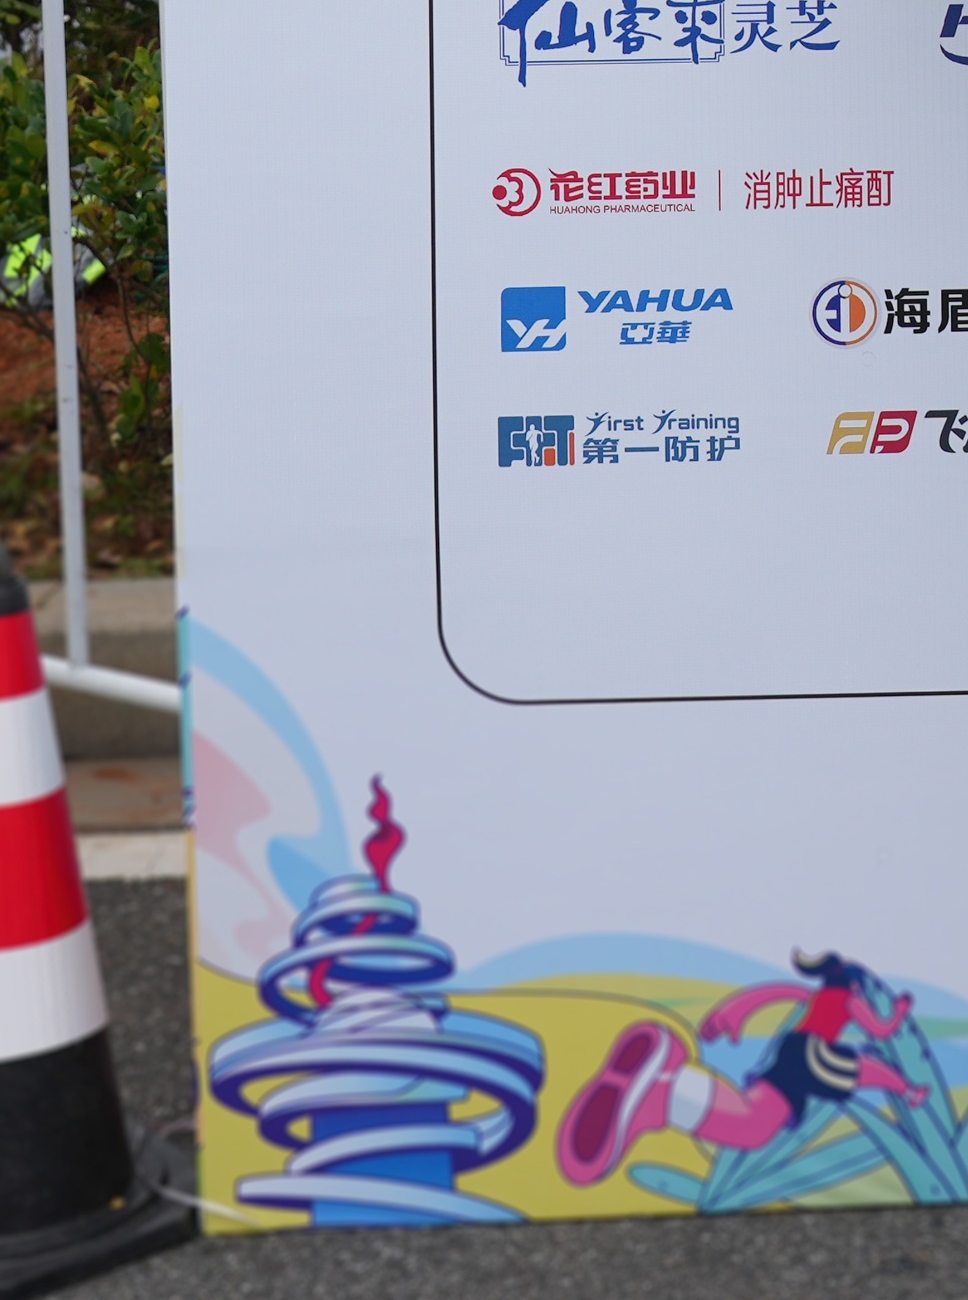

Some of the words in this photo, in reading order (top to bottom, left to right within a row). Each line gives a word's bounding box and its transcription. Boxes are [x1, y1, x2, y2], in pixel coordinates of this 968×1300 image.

[729, 0, 841, 54] 灵芝
[549, 168, 696, 202] 花红药业
[744, 167, 894, 211] 消肿止痛酊
[549, 205, 601, 215] HUAHONG
[603, 204, 696, 214] PHARMACEUTICAL
[577, 288, 733, 313] YAHUA
[585, 411, 644, 436] First
[652, 409, 740, 435] Training
[582, 435, 741, 465] 第一防护
